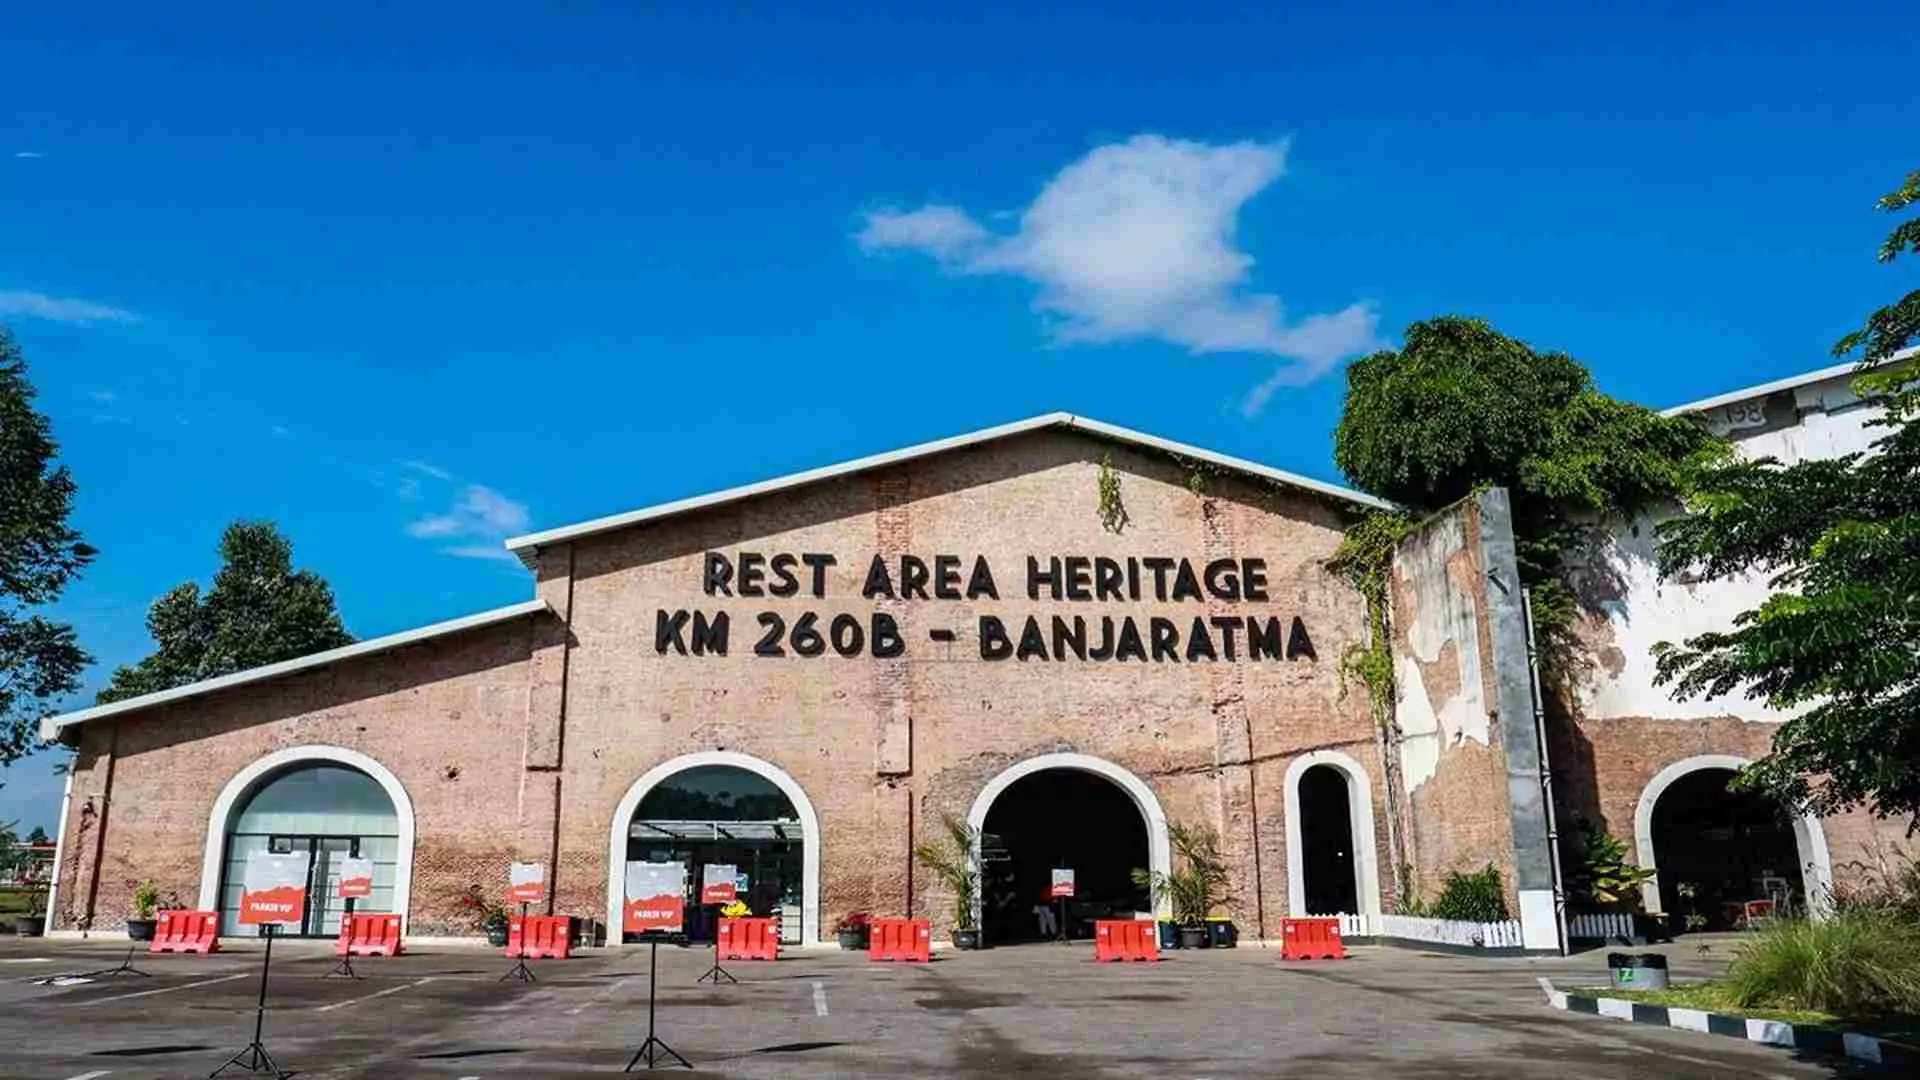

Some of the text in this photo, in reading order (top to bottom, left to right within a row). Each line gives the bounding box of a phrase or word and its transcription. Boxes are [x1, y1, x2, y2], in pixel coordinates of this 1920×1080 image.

[703, 552, 1269, 602] REST AREA HERITAGE
[655, 609, 730, 656] KM
[753, 611, 906, 658] 260B
[979, 614, 1319, 662] BANJARATMA
